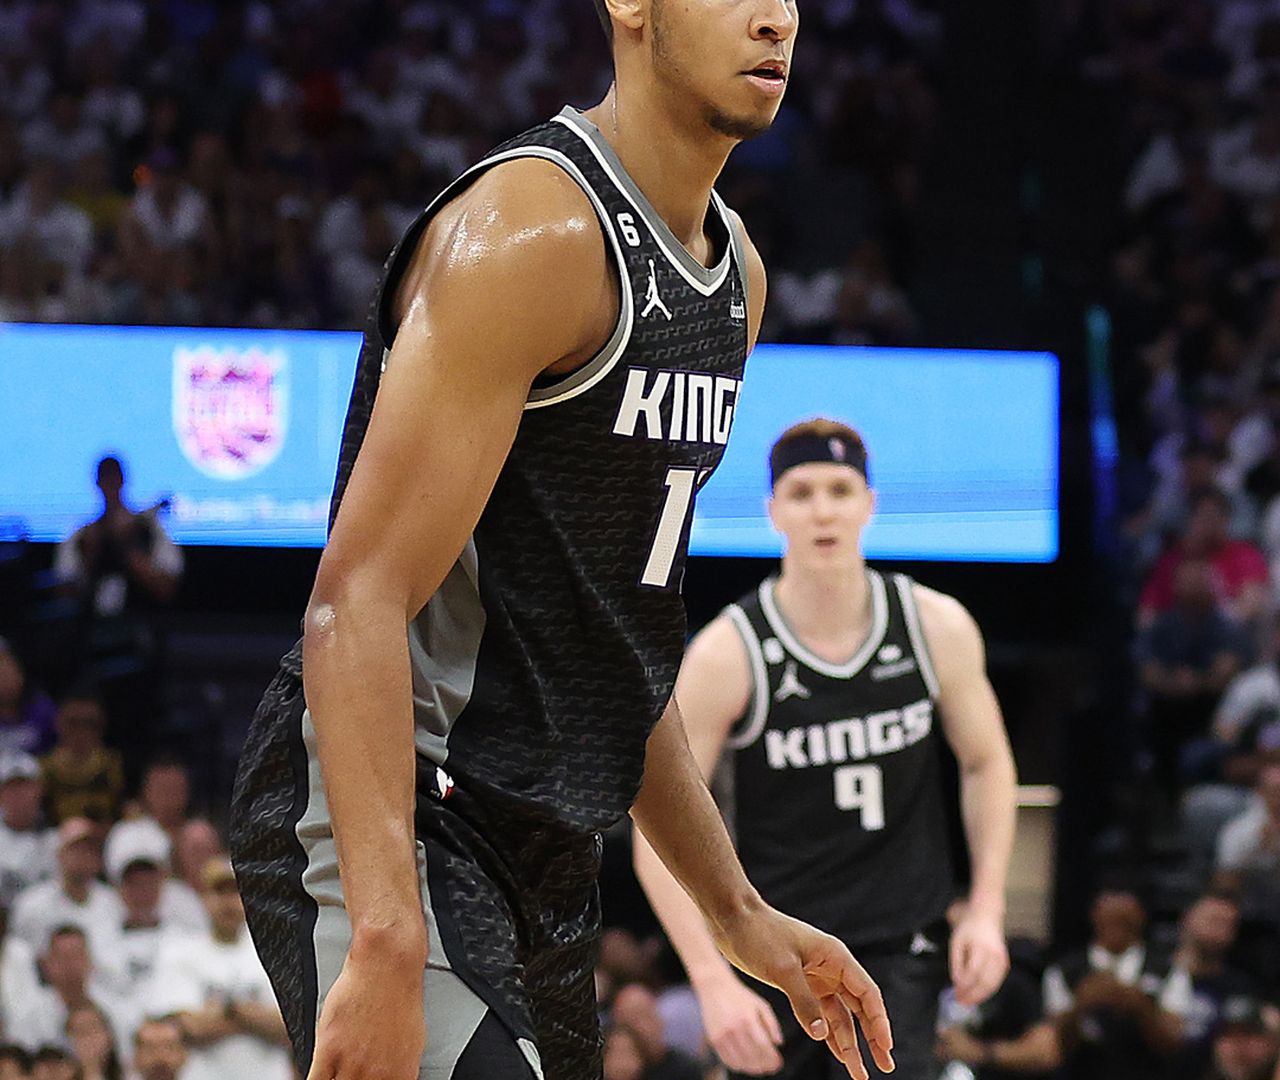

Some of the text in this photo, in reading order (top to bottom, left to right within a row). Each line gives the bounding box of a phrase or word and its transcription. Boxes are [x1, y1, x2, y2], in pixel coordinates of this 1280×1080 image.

[616, 212, 641, 247] 6
[612, 369, 743, 445] KING
[641, 468, 708, 588] 1
[764, 699, 933, 769] KINGS
[833, 763, 885, 831] 9
